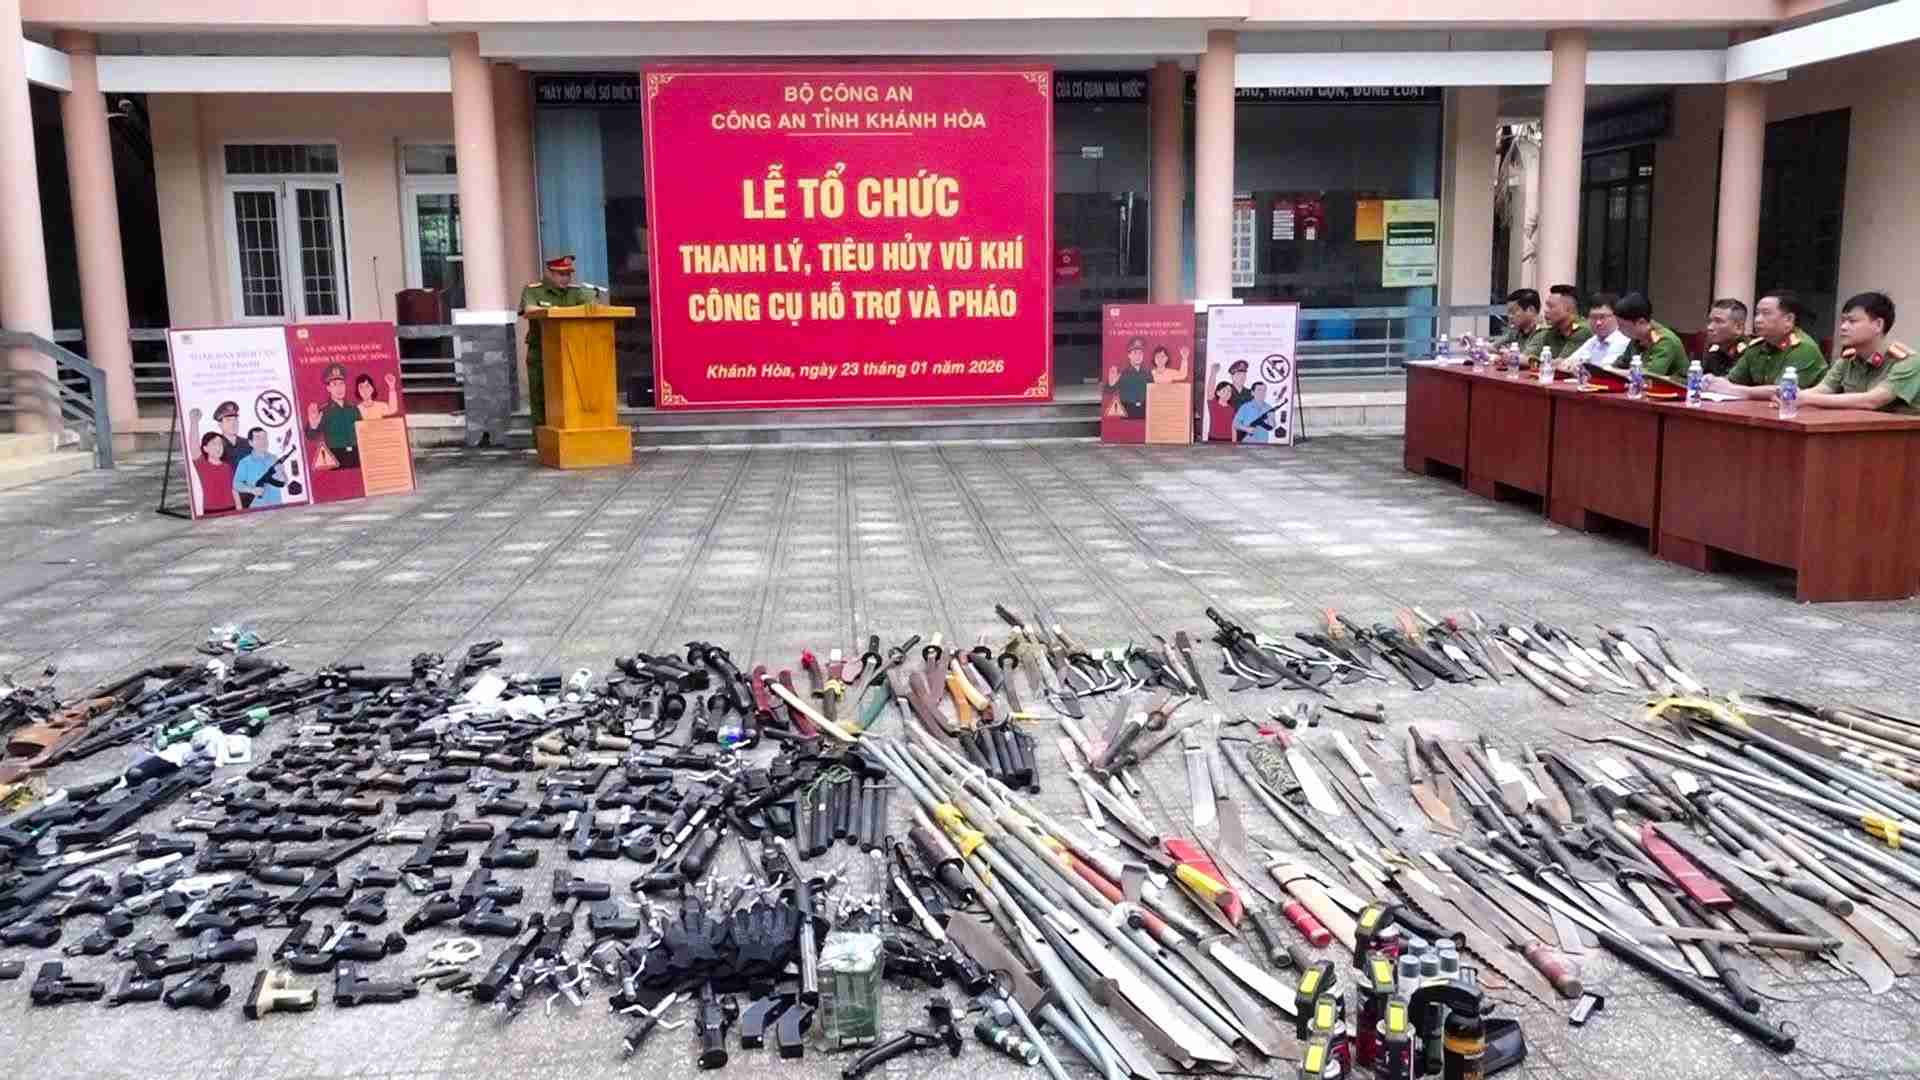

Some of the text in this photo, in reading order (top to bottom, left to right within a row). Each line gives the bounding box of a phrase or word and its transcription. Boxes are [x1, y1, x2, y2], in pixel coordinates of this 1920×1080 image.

[784, 83, 913, 105] BỘ CÔNG AN
[711, 107, 986, 130] CÔNG AN TỈNH KHÁNH HÒA
[742, 162, 960, 219] LỄ TỔ CHỨC
[679, 234, 1024, 276] THANH LÝ, TIÊU HỦY VŨ KHÍ
[688, 282, 1017, 326] CÔNG CỤ HỖ TRỢ VÀ PHÁO
[706, 360, 1005, 380] Khánh Hòa, ngày 23 tháng 01 năm 2026
